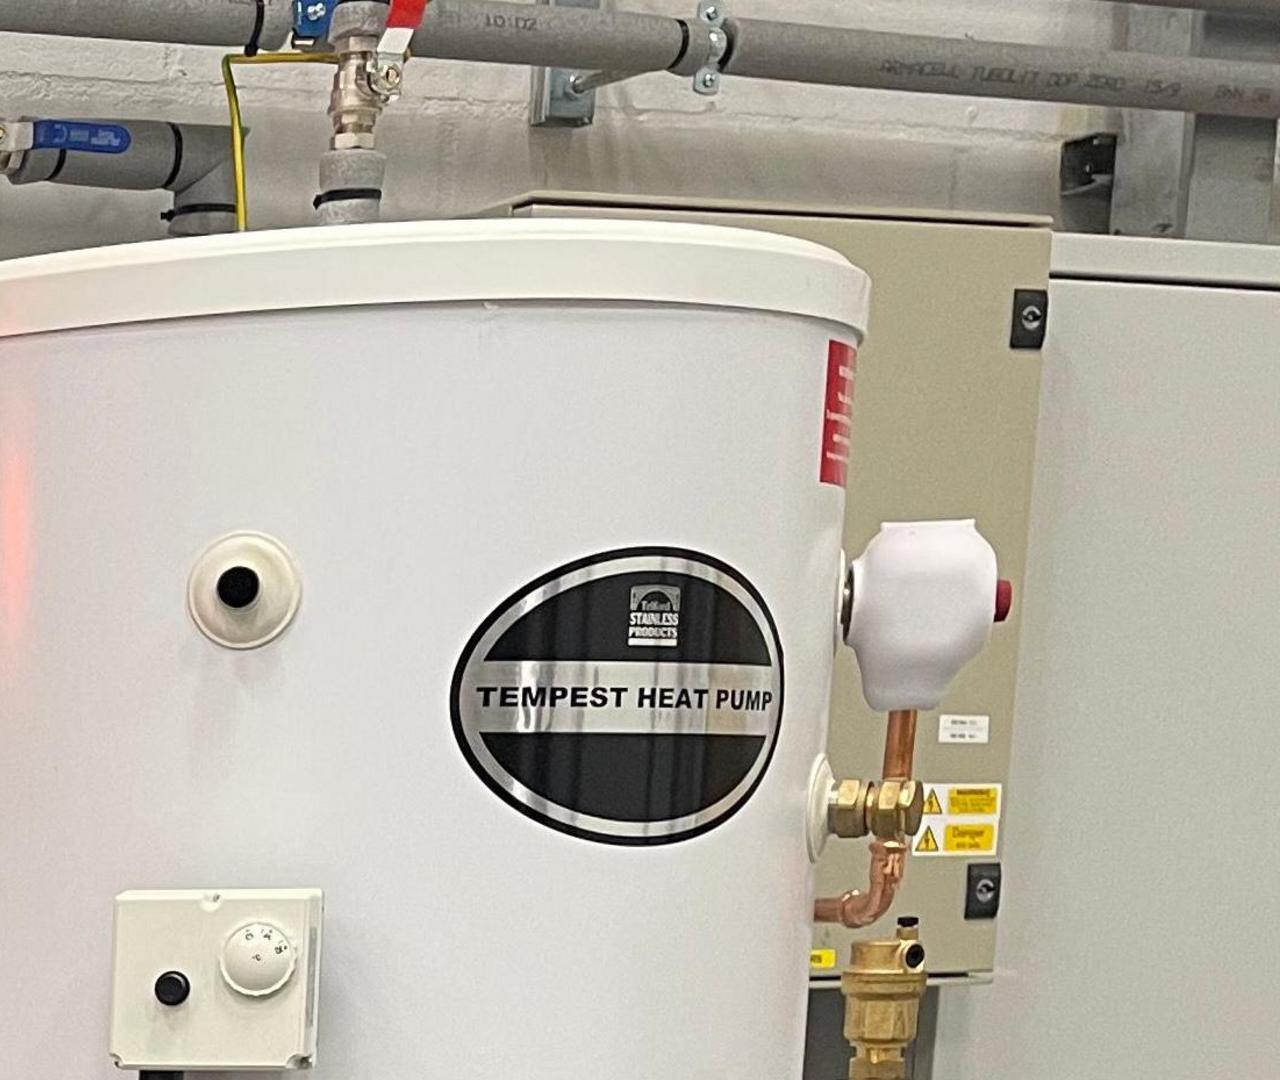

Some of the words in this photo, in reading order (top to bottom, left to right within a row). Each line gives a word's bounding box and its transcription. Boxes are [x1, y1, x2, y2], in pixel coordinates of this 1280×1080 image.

[629, 612, 679, 626] STAINLESS
[628, 626, 678, 638] PRODUCTS
[476, 686, 628, 708] TEMPEST
[638, 687, 709, 709] HEAT
[715, 689, 773, 712] PUMP
